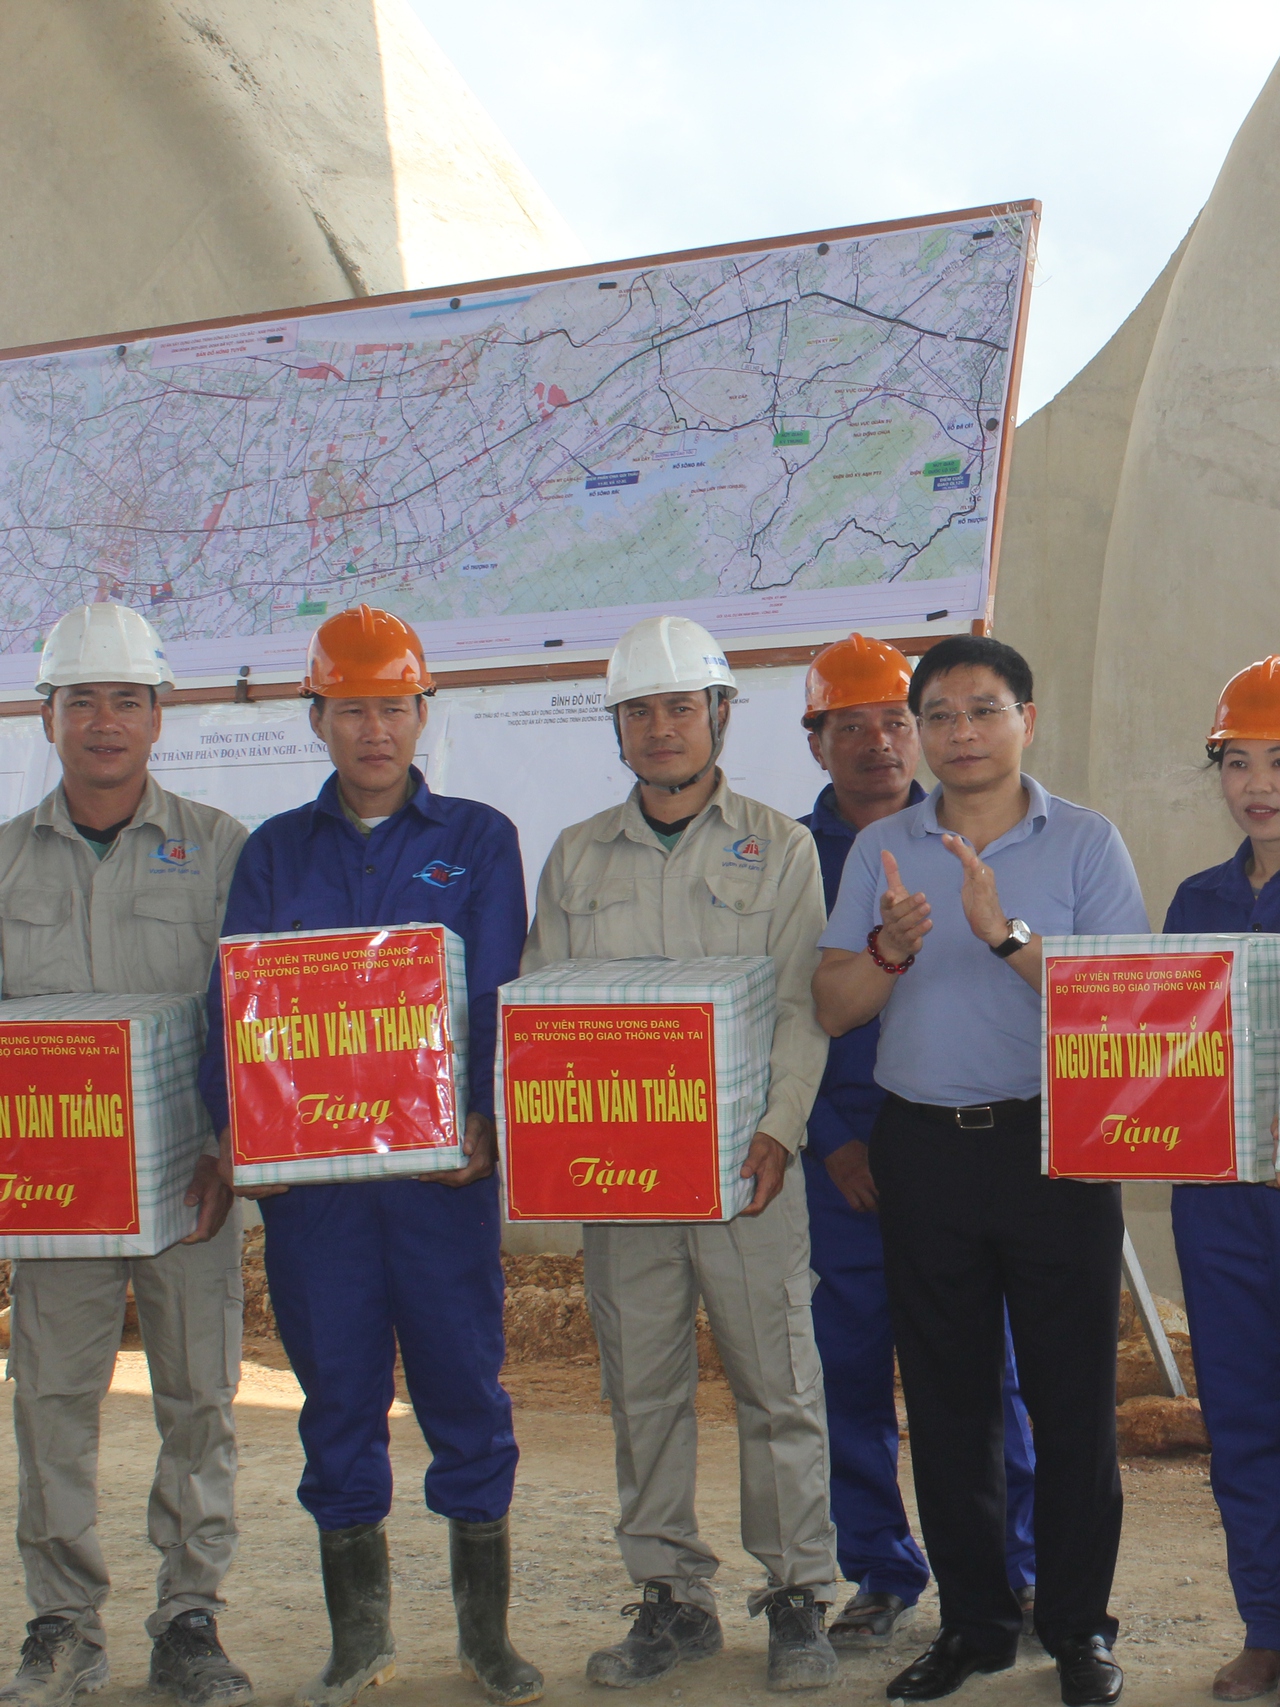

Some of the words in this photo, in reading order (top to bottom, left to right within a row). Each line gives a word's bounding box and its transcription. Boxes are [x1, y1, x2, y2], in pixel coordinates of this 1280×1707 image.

[552, 695, 570, 706] BÌNH
[585, 693, 601, 704] NÚT
[200, 732, 232, 744] THÔNG
[234, 732, 250, 743] TIN
[251, 731, 284, 741] CHUNG
[162, 749, 193, 762] THÀNH
[220, 747, 247, 760] ĐOẠN
[249, 744, 271, 757] HÀM
[273, 745, 297, 755] NGHI
[257, 956, 272, 967] ỦY
[274, 955, 299, 965] VIÊN
[303, 952, 339, 962] TRUNG
[342, 948, 376, 960] ƯƠNG
[378, 945, 410, 956] ĐẢNG
[235, 969, 250, 980] BỘ
[253, 965, 300, 978] TRƯỞNG
[303, 964, 319, 975] BỘ
[321, 962, 349, 972] GIAO
[352, 960, 389, 971] THÔNG
[392, 958, 414, 969] VẬN
[418, 955, 434, 965] TẢI
[1074, 970, 1088, 982] ỦY
[1090, 970, 1110, 981] VIÊN
[1112, 971, 1144, 981] TRUNG
[1146, 969, 1173, 980] ƯƠNG
[1175, 967, 1202, 979] ĐẢNG
[1056, 985, 1069, 996] BỘ
[1071, 984, 1110, 994] TRƯỞNG
[1112, 983, 1126, 993] BỘ
[1128, 982, 1150, 992] GIAO
[1152, 982, 1184, 992] THÔNG
[1186, 982, 1206, 993] VẬN
[1209, 981, 1223, 990] TẢI
[235, 997, 320, 1064] NGUYỄN
[324, 1001, 367, 1056] VĂN
[371, 990, 439, 1052] THẮNG
[536, 1020, 550, 1030] ỦY
[551, 1019, 575, 1030] VIÊN
[578, 1020, 613, 1029] TRUNG
[616, 1019, 648, 1029] ƯƠNG
[650, 1019, 680, 1029] ĐẢNG
[0, 1036, 30, 1045] RUNG
[32, 1035, 64, 1044] ƯƠNG
[66, 1033, 96, 1044] ĐẢNG
[514, 1031, 529, 1043] BỘ
[531, 1031, 576, 1041] TRƯỞNG
[579, 1031, 594, 1043] BỘ
[596, 1031, 622, 1041] GIAO
[624, 1030, 660, 1040] THÔNG
[663, 1031, 685, 1042] VẬN
[687, 1030, 703, 1040] TẢI
[13, 1047, 39, 1056] GIAO
[41, 1045, 77, 1056] THÔNG
[79, 1045, 100, 1057] VẬN
[103, 1045, 120, 1055] TẢI
[1055, 1015, 1123, 1079] NGUYỄN
[1126, 1022, 1161, 1077] VĂN
[1166, 1015, 1225, 1077] THẮNG
[514, 1062, 593, 1124] NGUYỄN
[597, 1069, 638, 1123] VĂN
[642, 1064, 708, 1123] THẮNG
[15, 1084, 54, 1138] VĂN
[59, 1078, 124, 1138] THẮNG
[296, 1093, 394, 1129] Tặng
[1100, 1113, 1182, 1152] Tặng
[569, 1157, 660, 1194] Tặng
